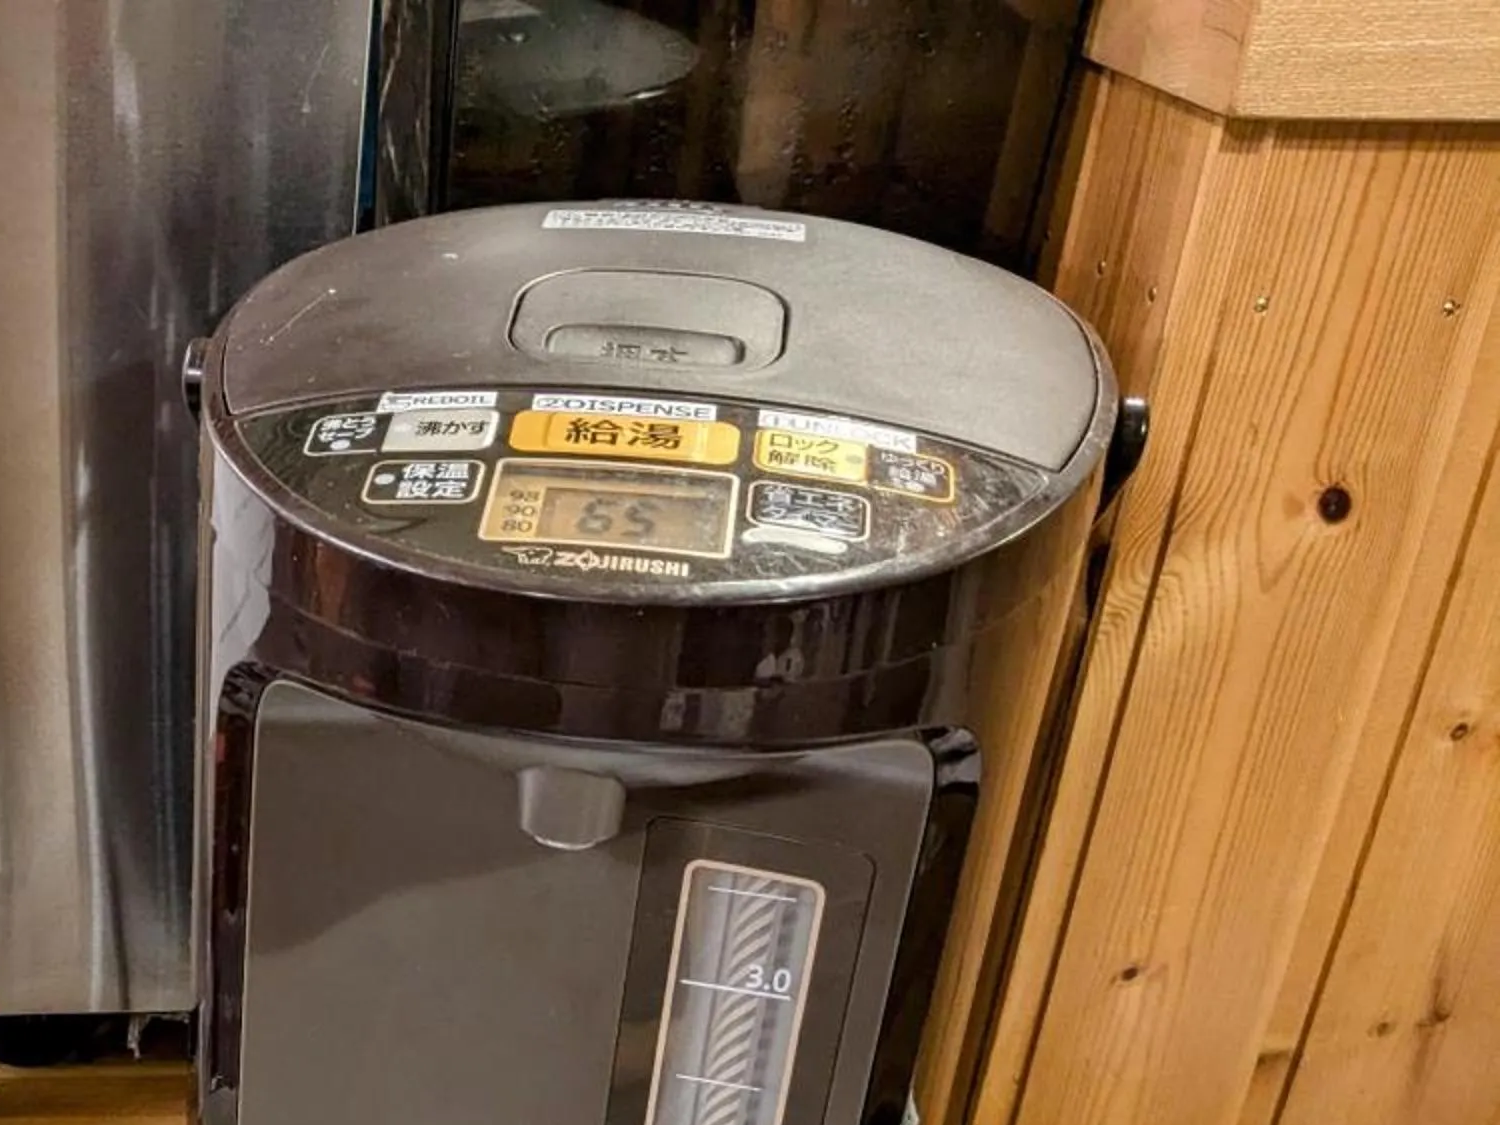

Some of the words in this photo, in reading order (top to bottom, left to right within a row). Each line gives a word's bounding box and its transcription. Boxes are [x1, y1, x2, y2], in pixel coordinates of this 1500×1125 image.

[566, 418, 683, 450] 給湯
[769, 433, 838, 454] ロック
[403, 462, 469, 479] 保温
[396, 480, 468, 499] 設定
[502, 519, 532, 533] 80
[576, 498, 660, 538] 65
[554, 550, 690, 577] ZOJIRUSHI
[746, 964, 792, 993] 3.0
